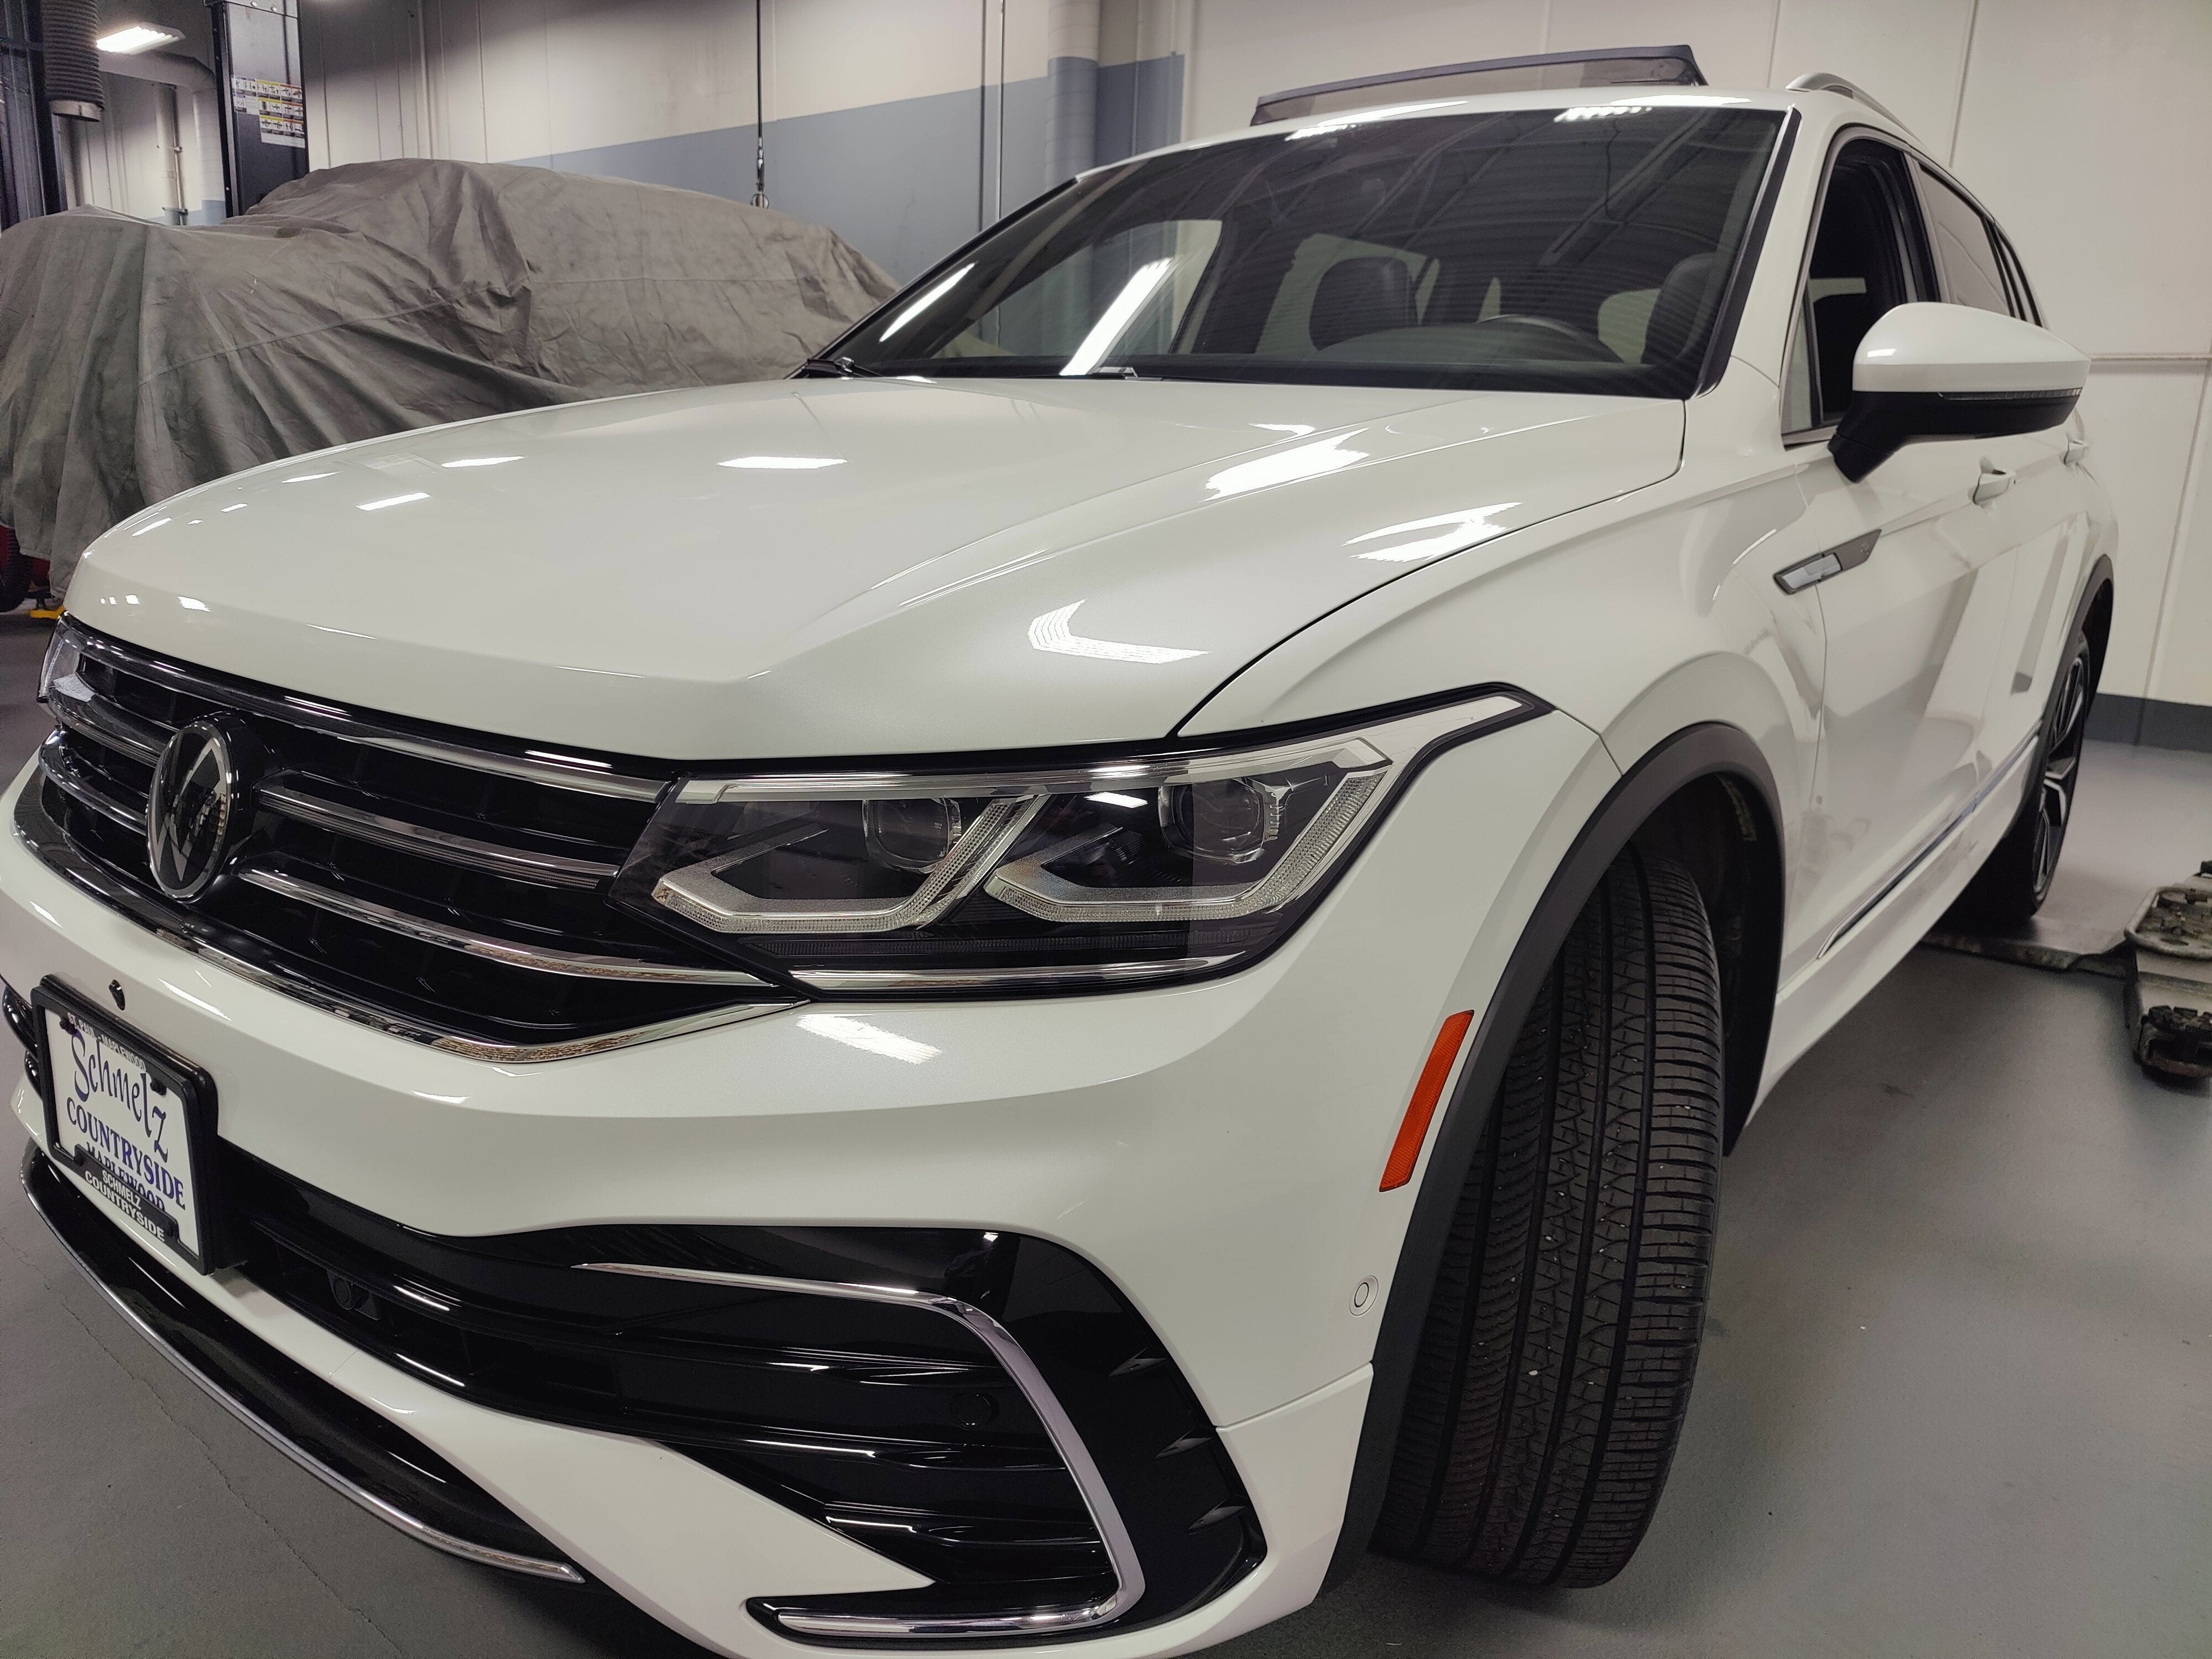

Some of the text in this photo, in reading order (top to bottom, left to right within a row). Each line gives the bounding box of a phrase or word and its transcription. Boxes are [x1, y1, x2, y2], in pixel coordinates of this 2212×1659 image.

[79, 1019, 96, 1039] PAUL
[101, 1034, 147, 1073] MAPLEWOOD
[71, 1027, 168, 1163] Schmelz
[67, 1097, 186, 1211] COUNTRYSIDE
[102, 1169, 142, 1211] SCHMELZ
[85, 1170, 165, 1243] COUNTRYSIDE
